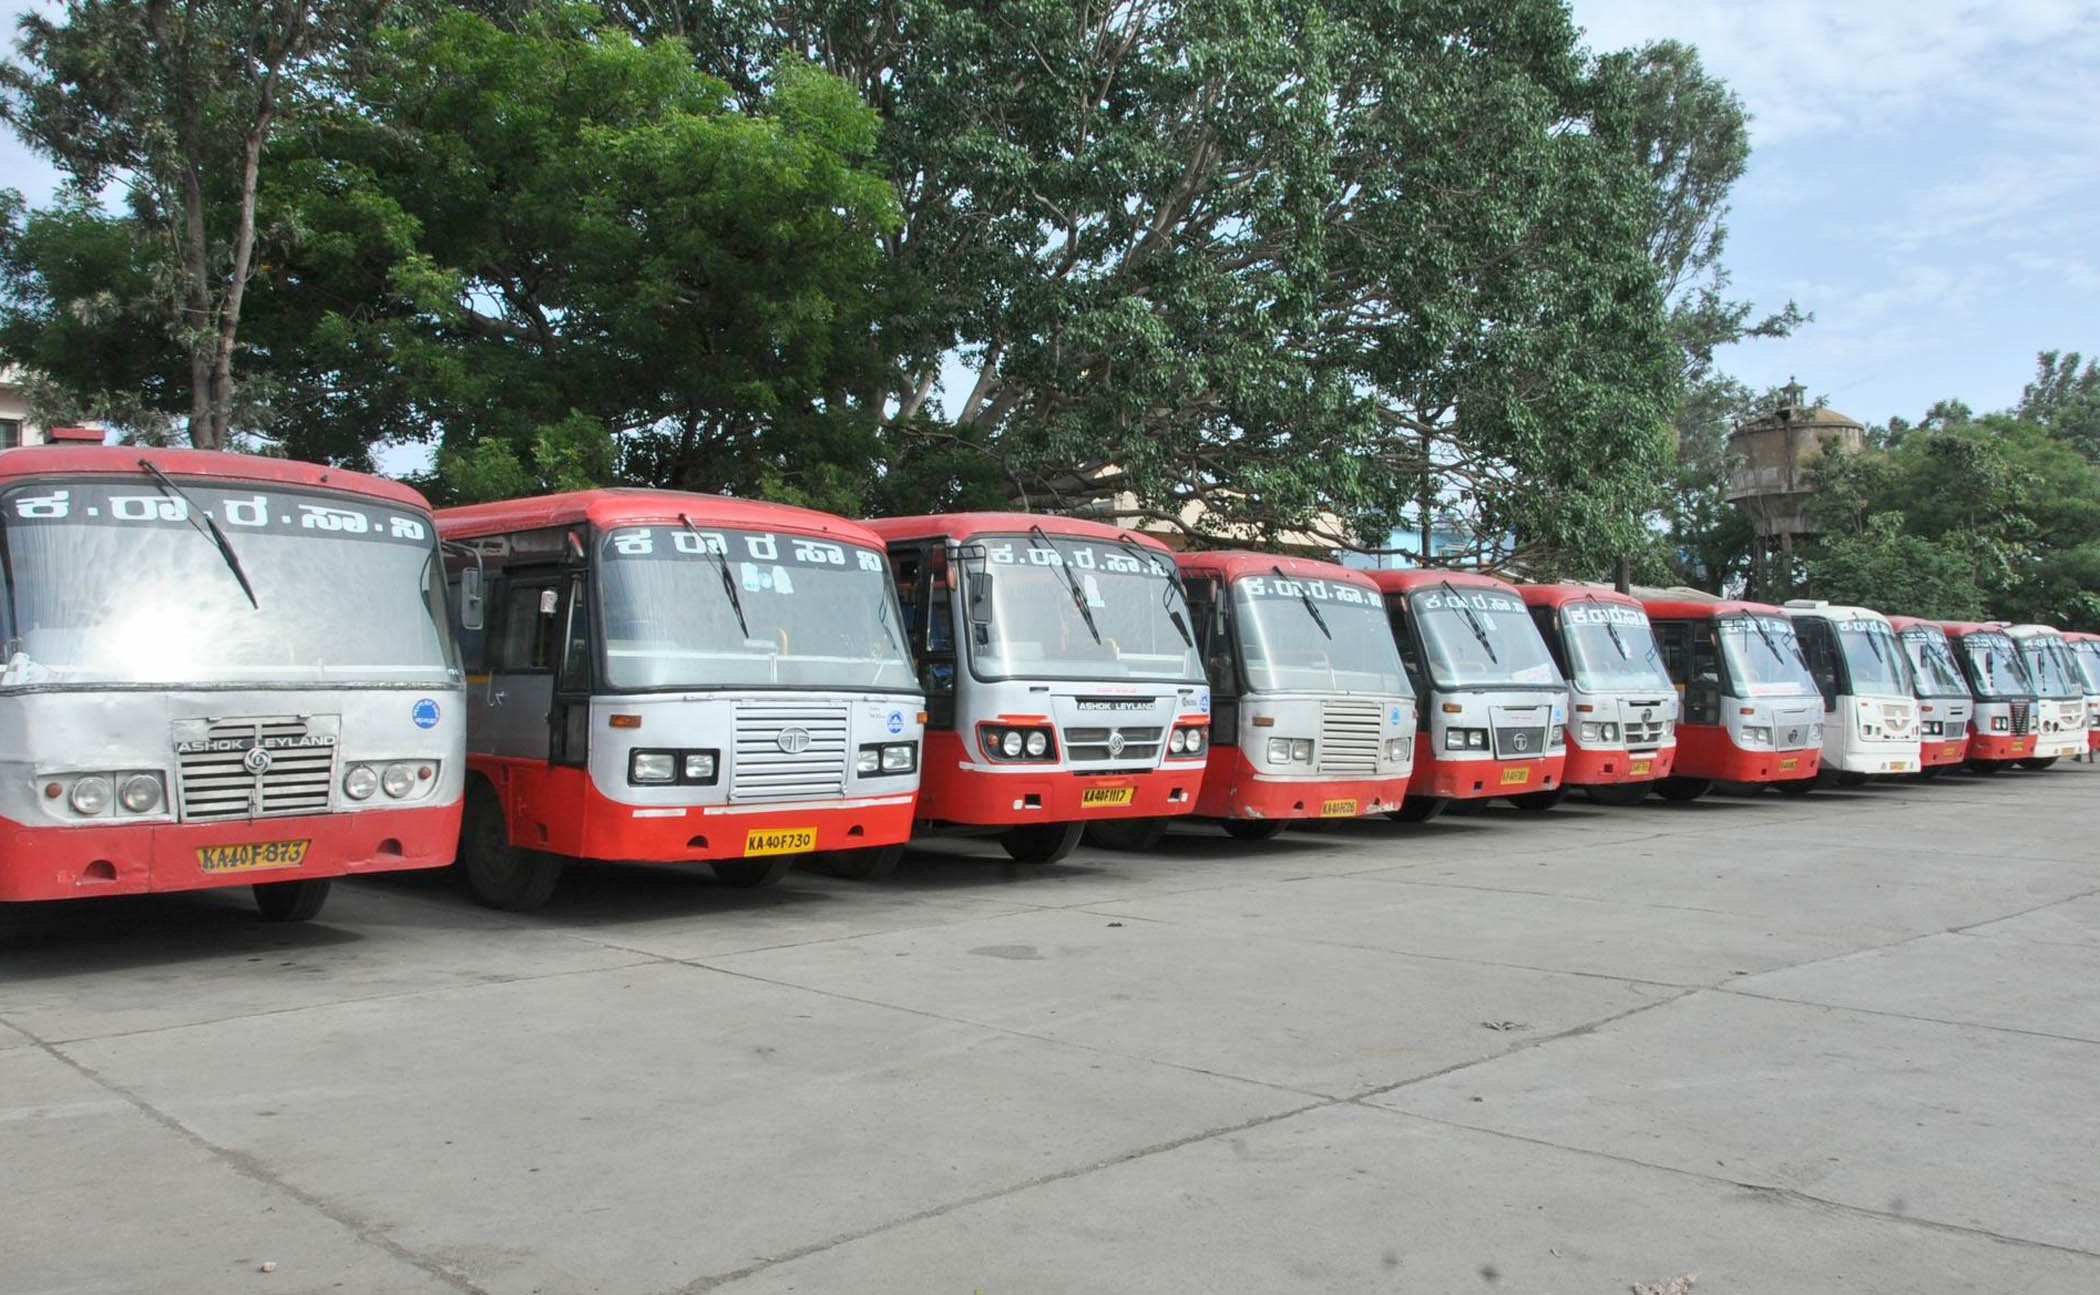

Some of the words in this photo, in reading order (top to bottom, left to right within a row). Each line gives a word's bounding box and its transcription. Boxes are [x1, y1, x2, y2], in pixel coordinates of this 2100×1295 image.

[1080, 702, 1111, 711] ASHOK
[1115, 702, 1155, 712] LEYLAND
[178, 739, 243, 753] ASHOK
[255, 736, 336, 749] LEYLAND
